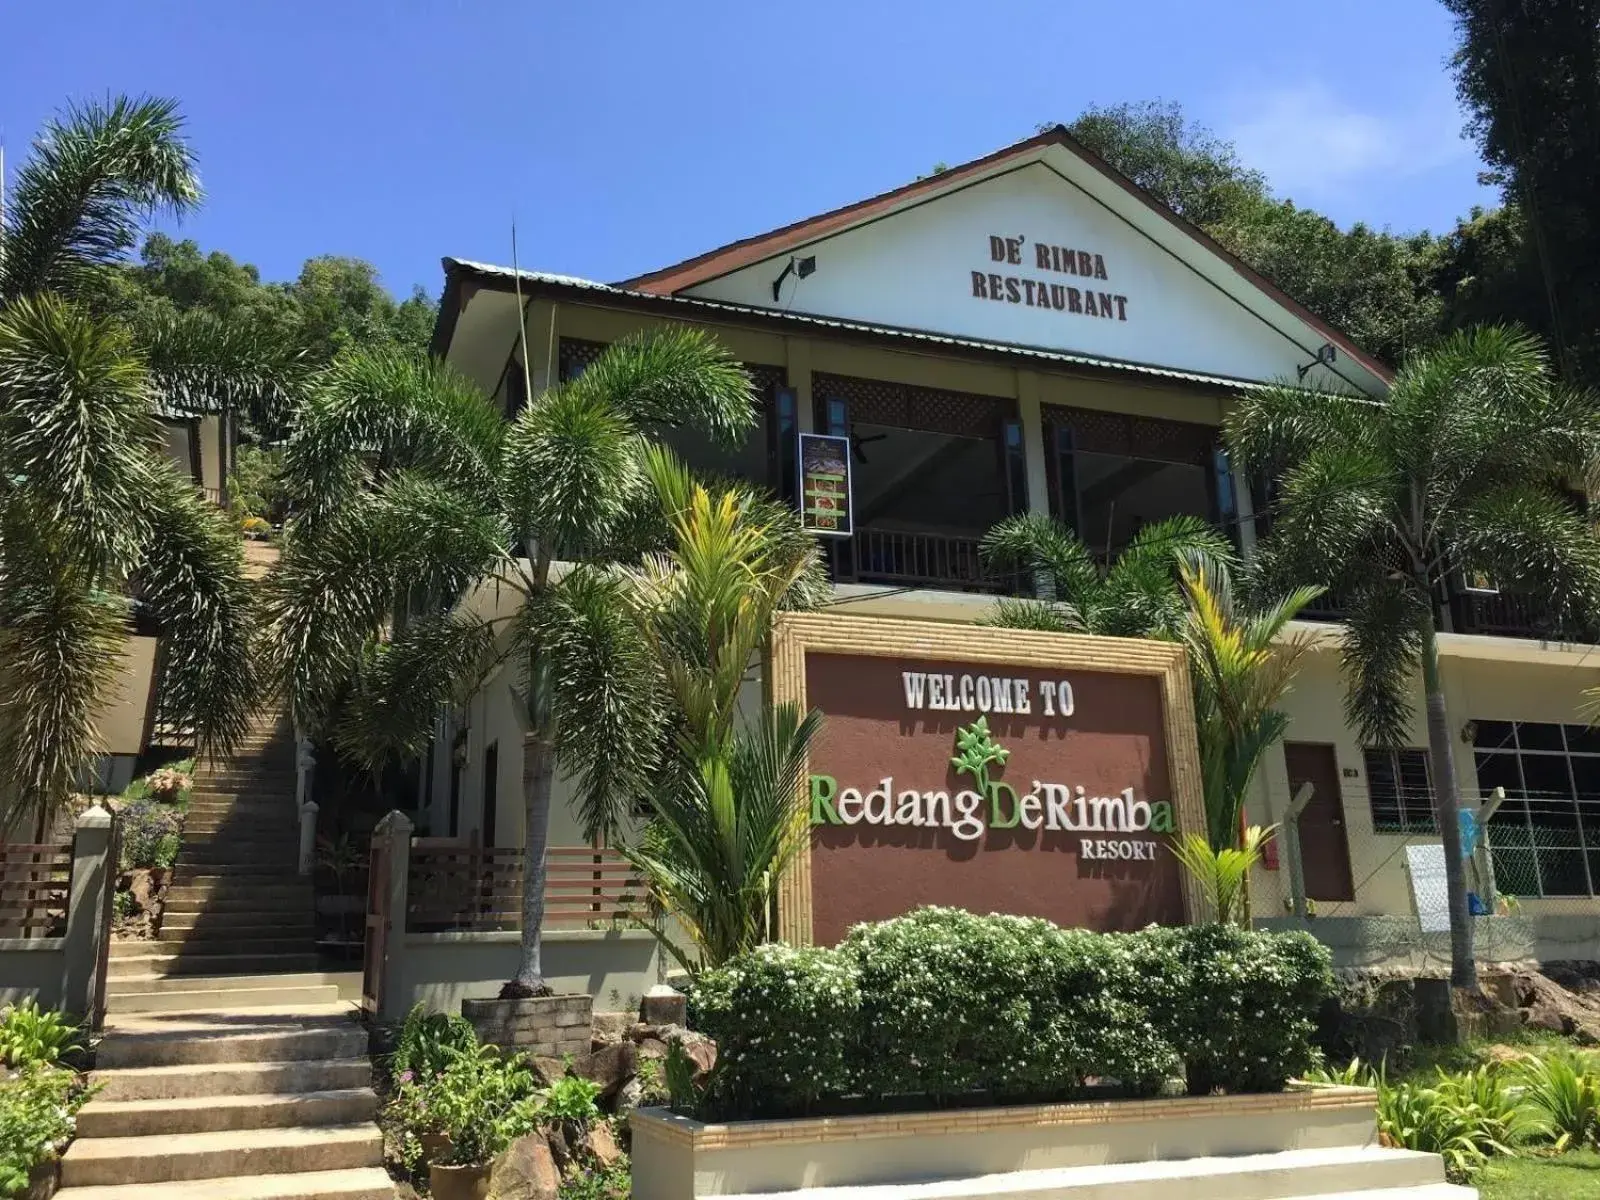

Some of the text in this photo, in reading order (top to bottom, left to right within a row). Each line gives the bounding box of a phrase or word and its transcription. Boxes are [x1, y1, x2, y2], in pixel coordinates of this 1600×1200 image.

[1035, 243, 1108, 280] RIMBA
[971, 270, 1128, 321] RESTAURANT
[902, 671, 1074, 717] WELCOME TO
[809, 774, 985, 841] Redang
[1080, 839, 1157, 861] RESORT
